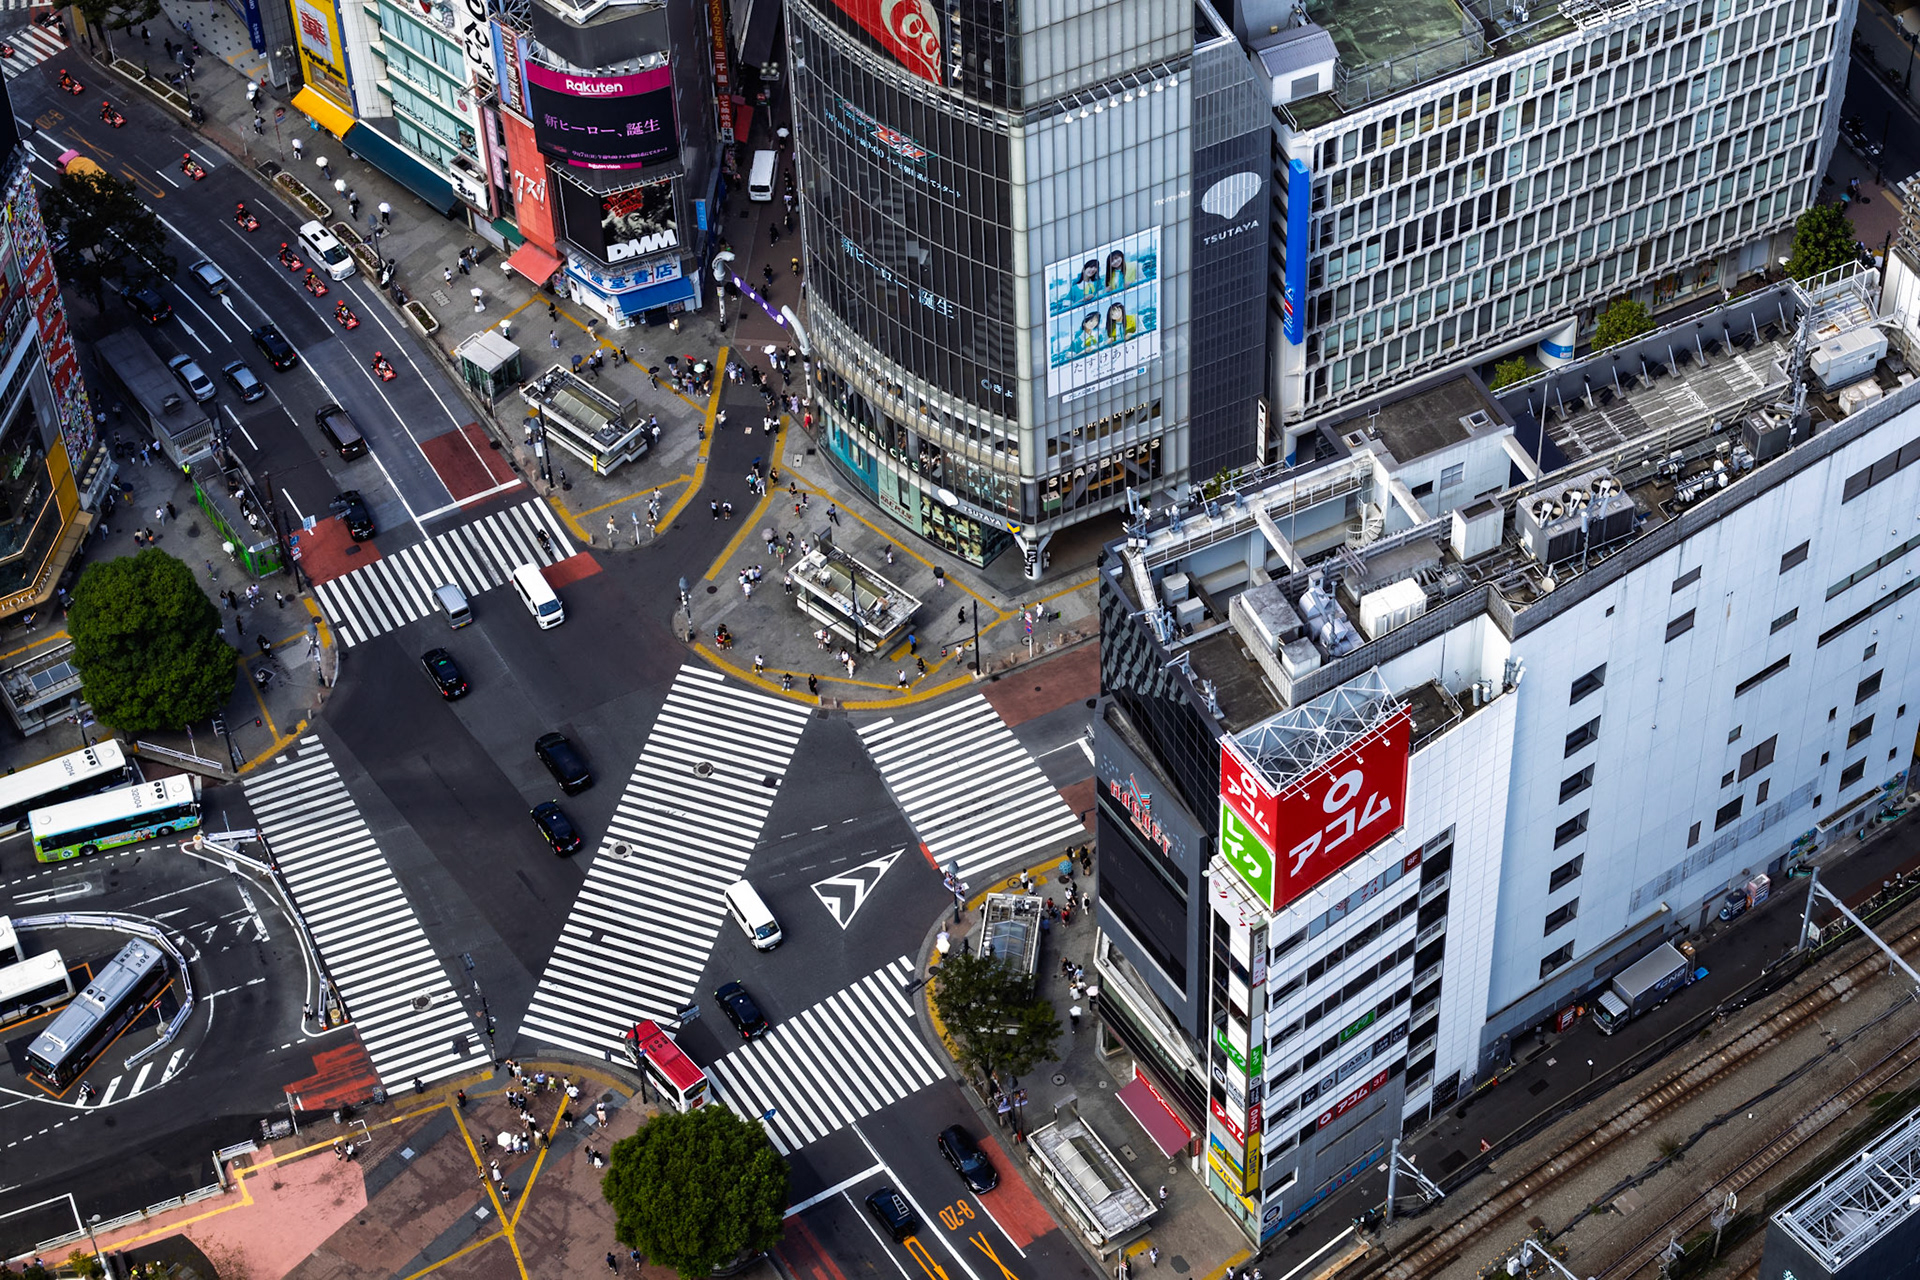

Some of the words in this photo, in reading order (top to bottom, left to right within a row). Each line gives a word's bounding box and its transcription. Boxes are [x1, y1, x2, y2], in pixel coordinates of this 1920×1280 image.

[714, 51, 728, 83] 三千里
[565, 78, 624, 93] Rakuten
[544, 113, 661, 138] 新ヒーロー、誕生
[606, 229, 678, 263] DMM
[1203, 219, 1260, 246] TSUTAYA
[841, 234, 955, 320] 新ヒーロー、誕生
[5, 298, 24, 336] ガスト
[1073, 344, 1135, 374] たすけあい
[834, 399, 920, 472] STARBUCKS
[1048, 438, 1160, 488] STARBUCKS
[962, 505, 1002, 526] TSUTAYA
[131, 787, 142, 808] 32004
[1227, 774, 1270, 836] アコム
[1110, 779, 1171, 858] MAGNET
[1289, 791, 1392, 878] アコム
[1225, 811, 1263, 878] レイク
[136, 954, 150, 968] 306
[1344, 1015, 1369, 1037] レイク
[1219, 1032, 1247, 1067] レイク
[1373, 1073, 1386, 1087] 3F
[1337, 1087, 1368, 1113] アコム
[1215, 1104, 1245, 1144] アコム
[939, 1199, 976, 1230] 8-20
